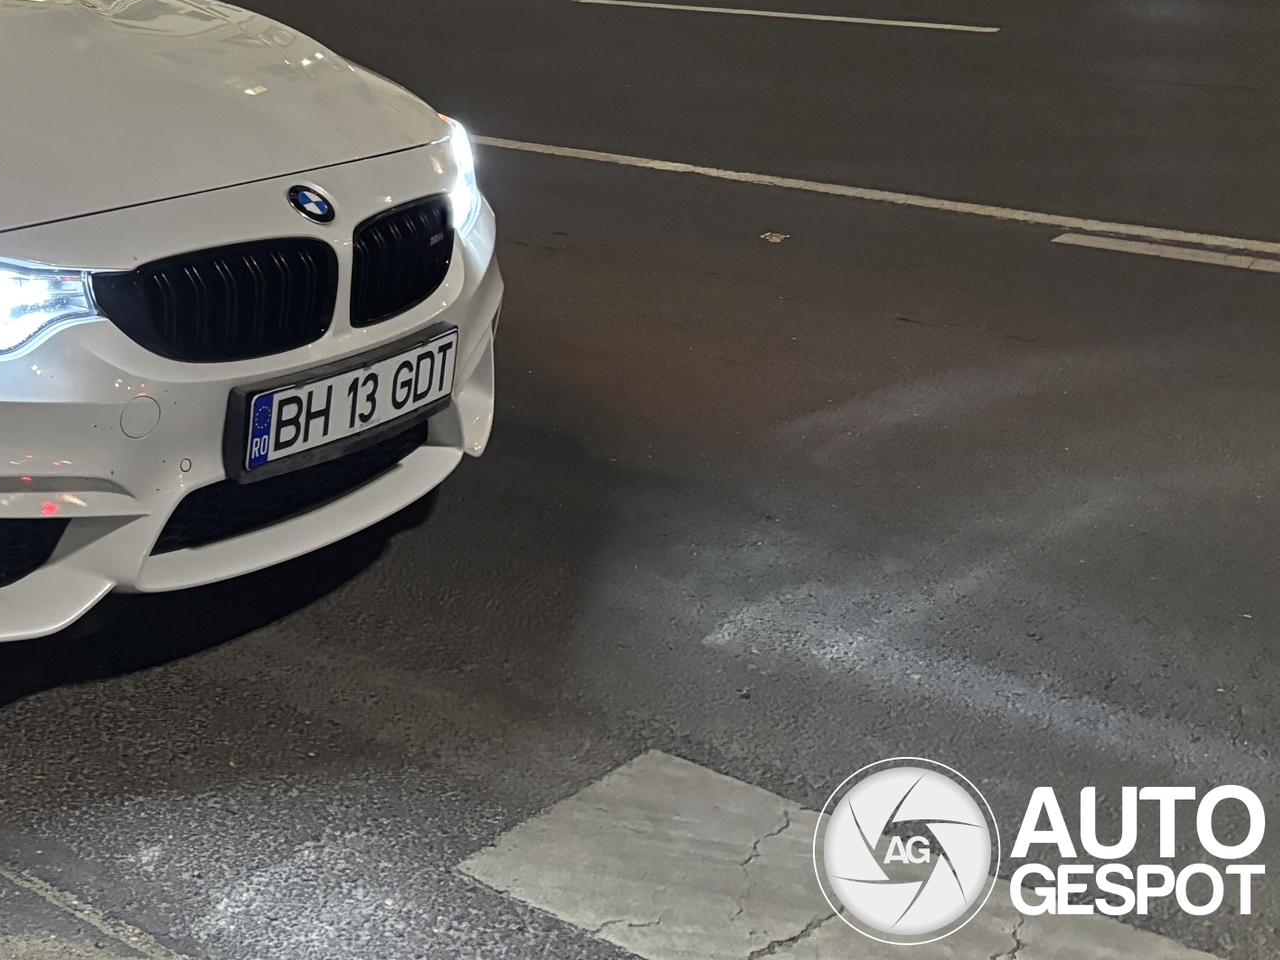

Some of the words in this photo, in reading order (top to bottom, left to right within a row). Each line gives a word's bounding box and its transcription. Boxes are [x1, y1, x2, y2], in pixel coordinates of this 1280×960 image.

[251, 433, 269, 460] RO
[273, 385, 333, 452] BH
[346, 371, 379, 430] 13
[391, 341, 454, 411] GDT
